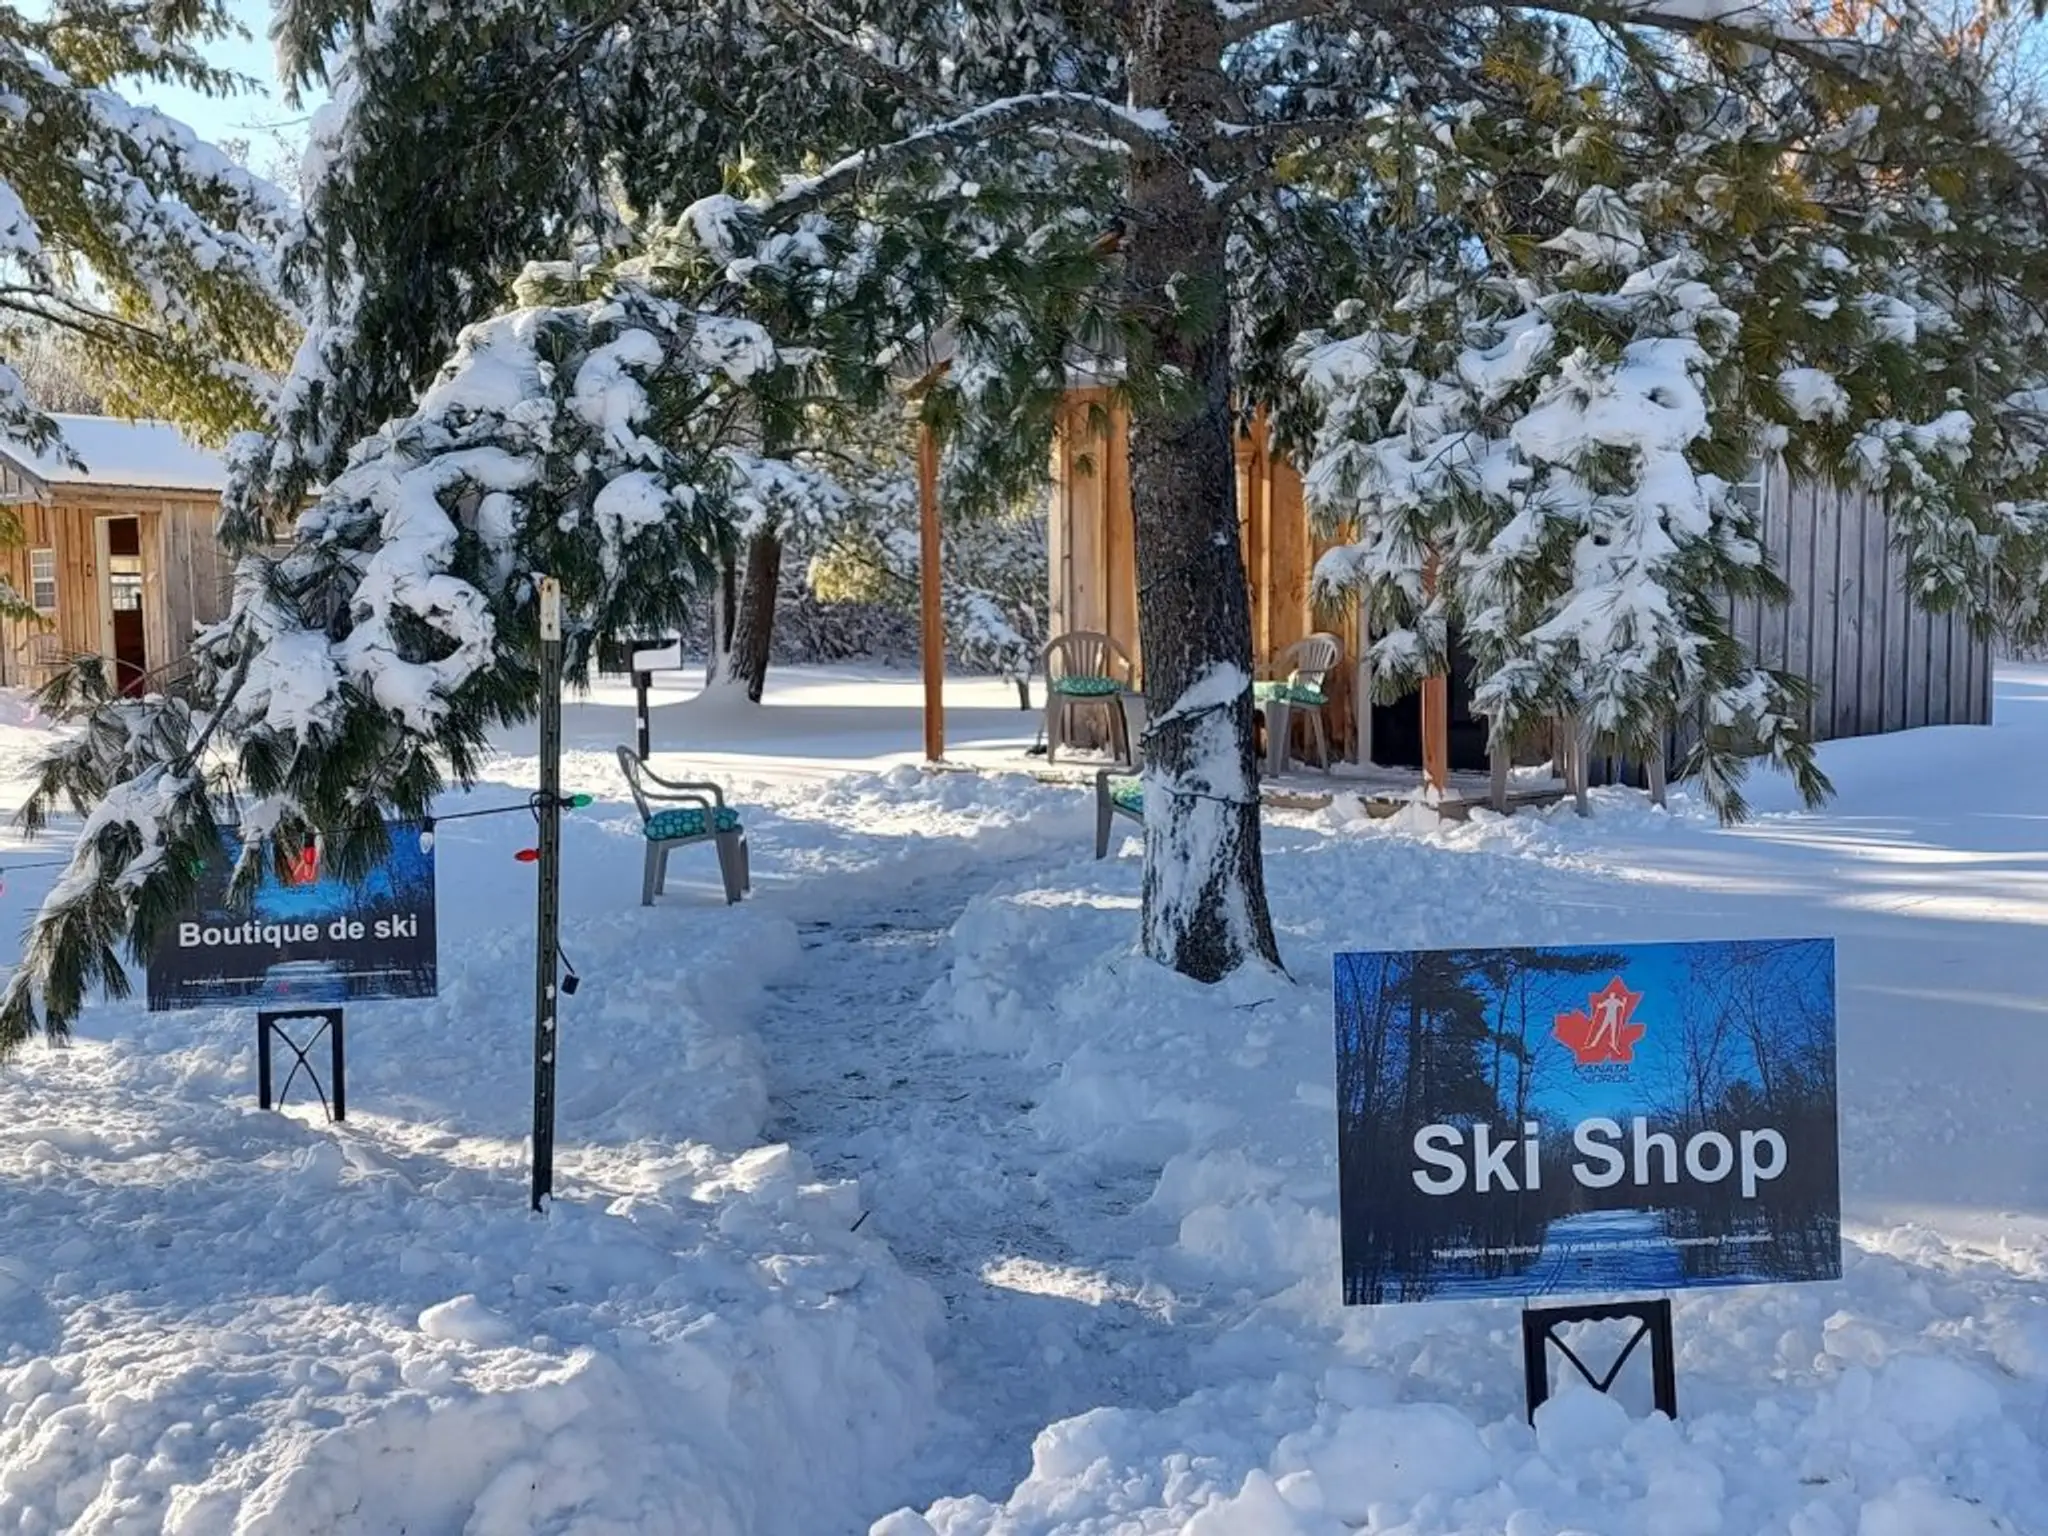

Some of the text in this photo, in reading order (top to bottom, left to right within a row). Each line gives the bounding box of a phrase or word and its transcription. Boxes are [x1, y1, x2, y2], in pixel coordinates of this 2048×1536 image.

[178, 913, 418, 949] Boutique de ski
[1411, 1116, 1788, 1199] Ski Shop
